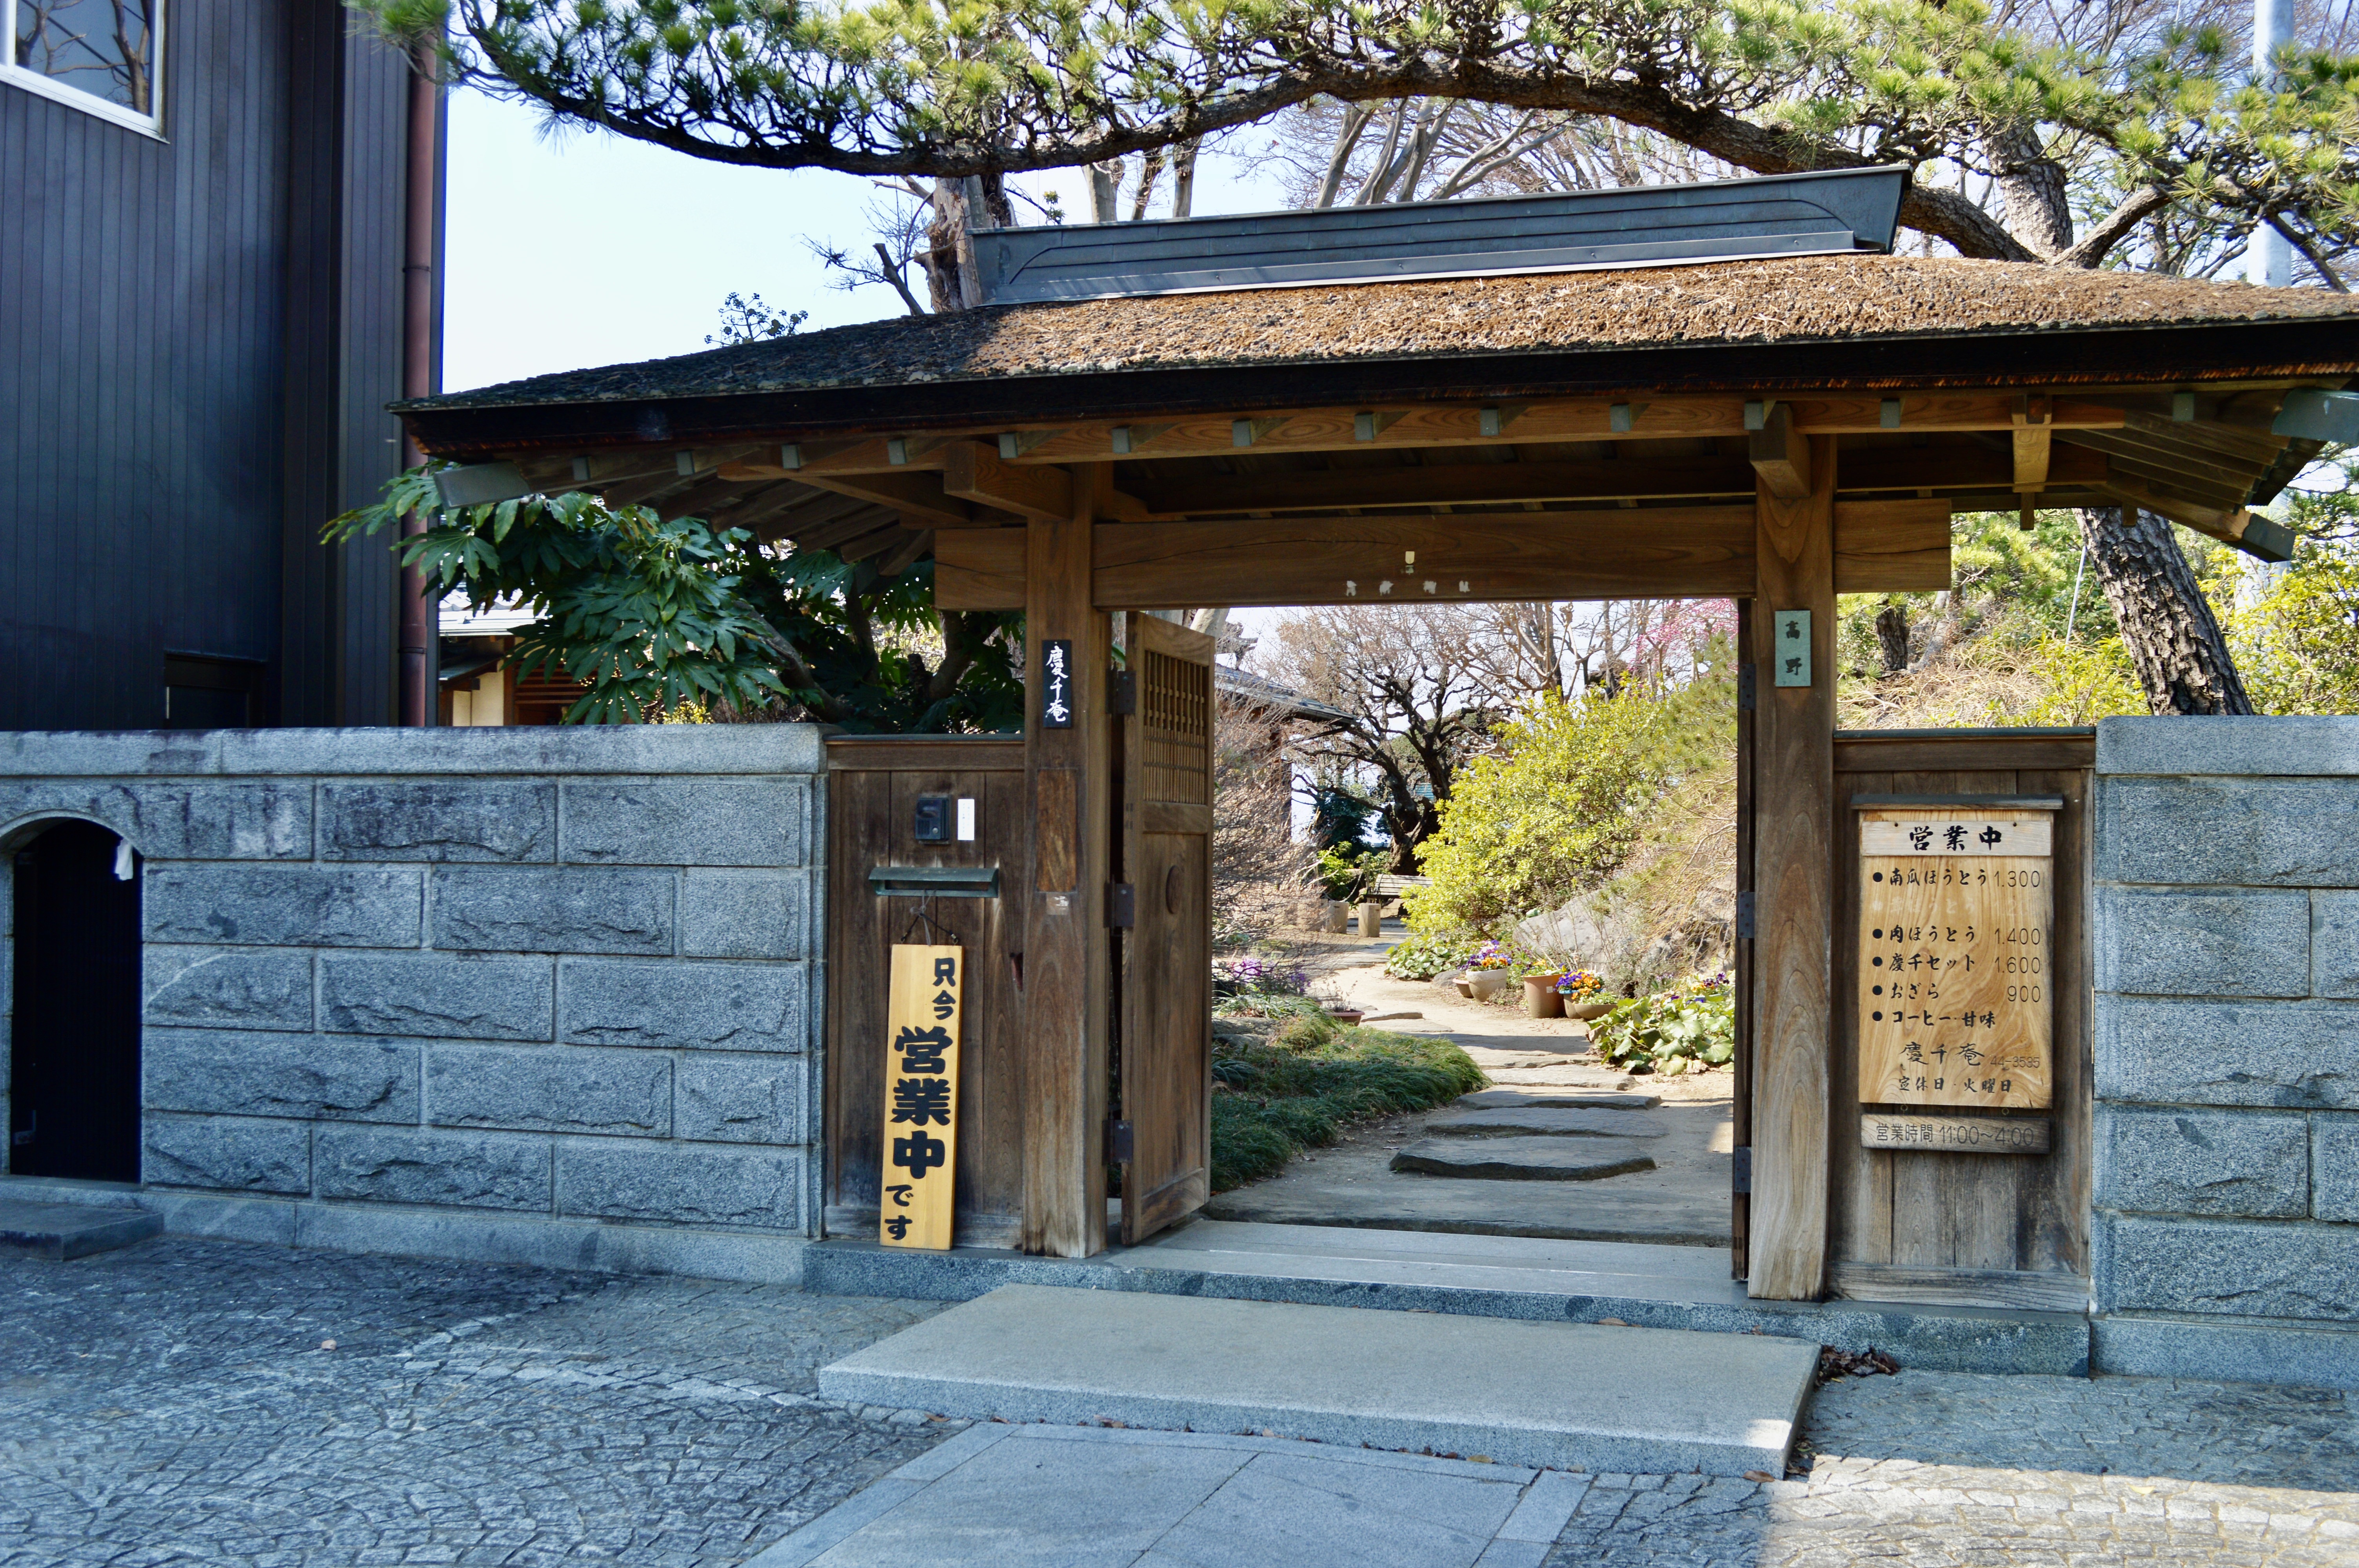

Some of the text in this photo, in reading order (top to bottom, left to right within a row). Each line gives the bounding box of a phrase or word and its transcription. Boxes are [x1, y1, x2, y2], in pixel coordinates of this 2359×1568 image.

[1910, 825, 2002, 851] 営業中
[1890, 867, 1986, 887] 南瓜ほうとう
[1890, 924, 1975, 944] 肉ほうとう
[1889, 953, 1975, 972] 慶千セット
[1890, 982, 2041, 1003] おざら 900
[1898, 1041, 2040, 1069] 慶千庵 44-3535
[1876, 1123, 1933, 1142] 営業時間
